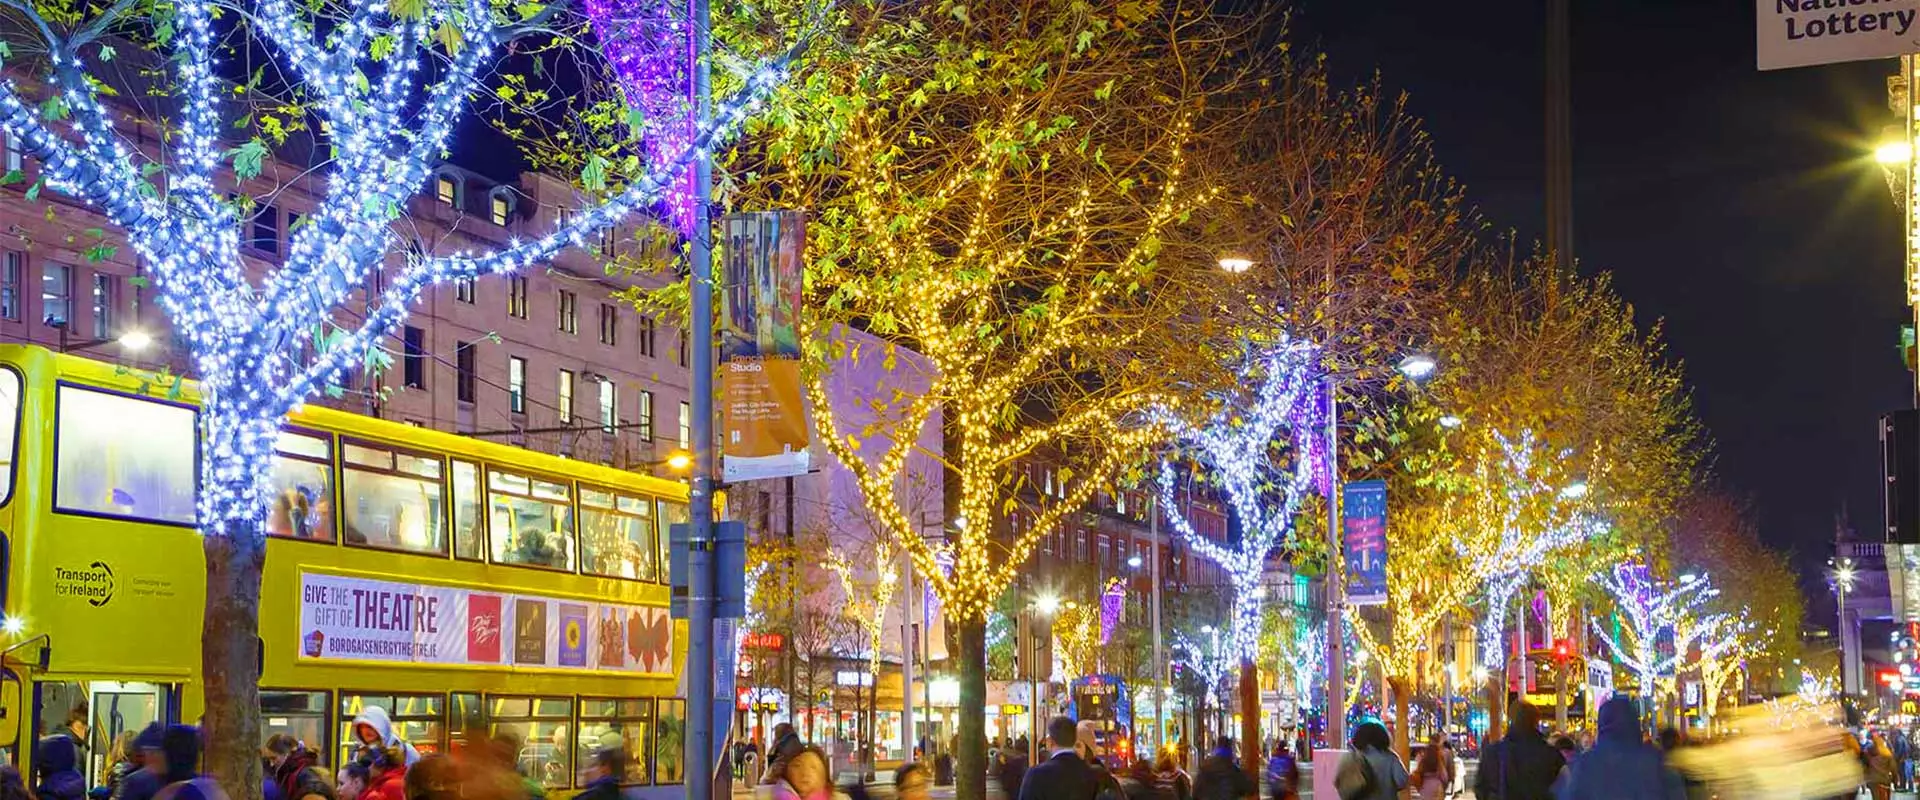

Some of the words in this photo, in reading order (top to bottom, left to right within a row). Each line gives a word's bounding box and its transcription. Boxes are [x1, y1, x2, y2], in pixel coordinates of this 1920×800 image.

[1786, 9, 1916, 40] Lottery
[731, 362, 762, 373] Studio
[55, 567, 107, 583] Transport
[55, 582, 69, 595] for
[69, 584, 106, 597] Ireland
[304, 584, 327, 604] GIVE
[330, 587, 349, 606] THE
[315, 607, 337, 625] GIFT
[340, 609, 353, 627] OF
[352, 589, 438, 634] THEATRE
